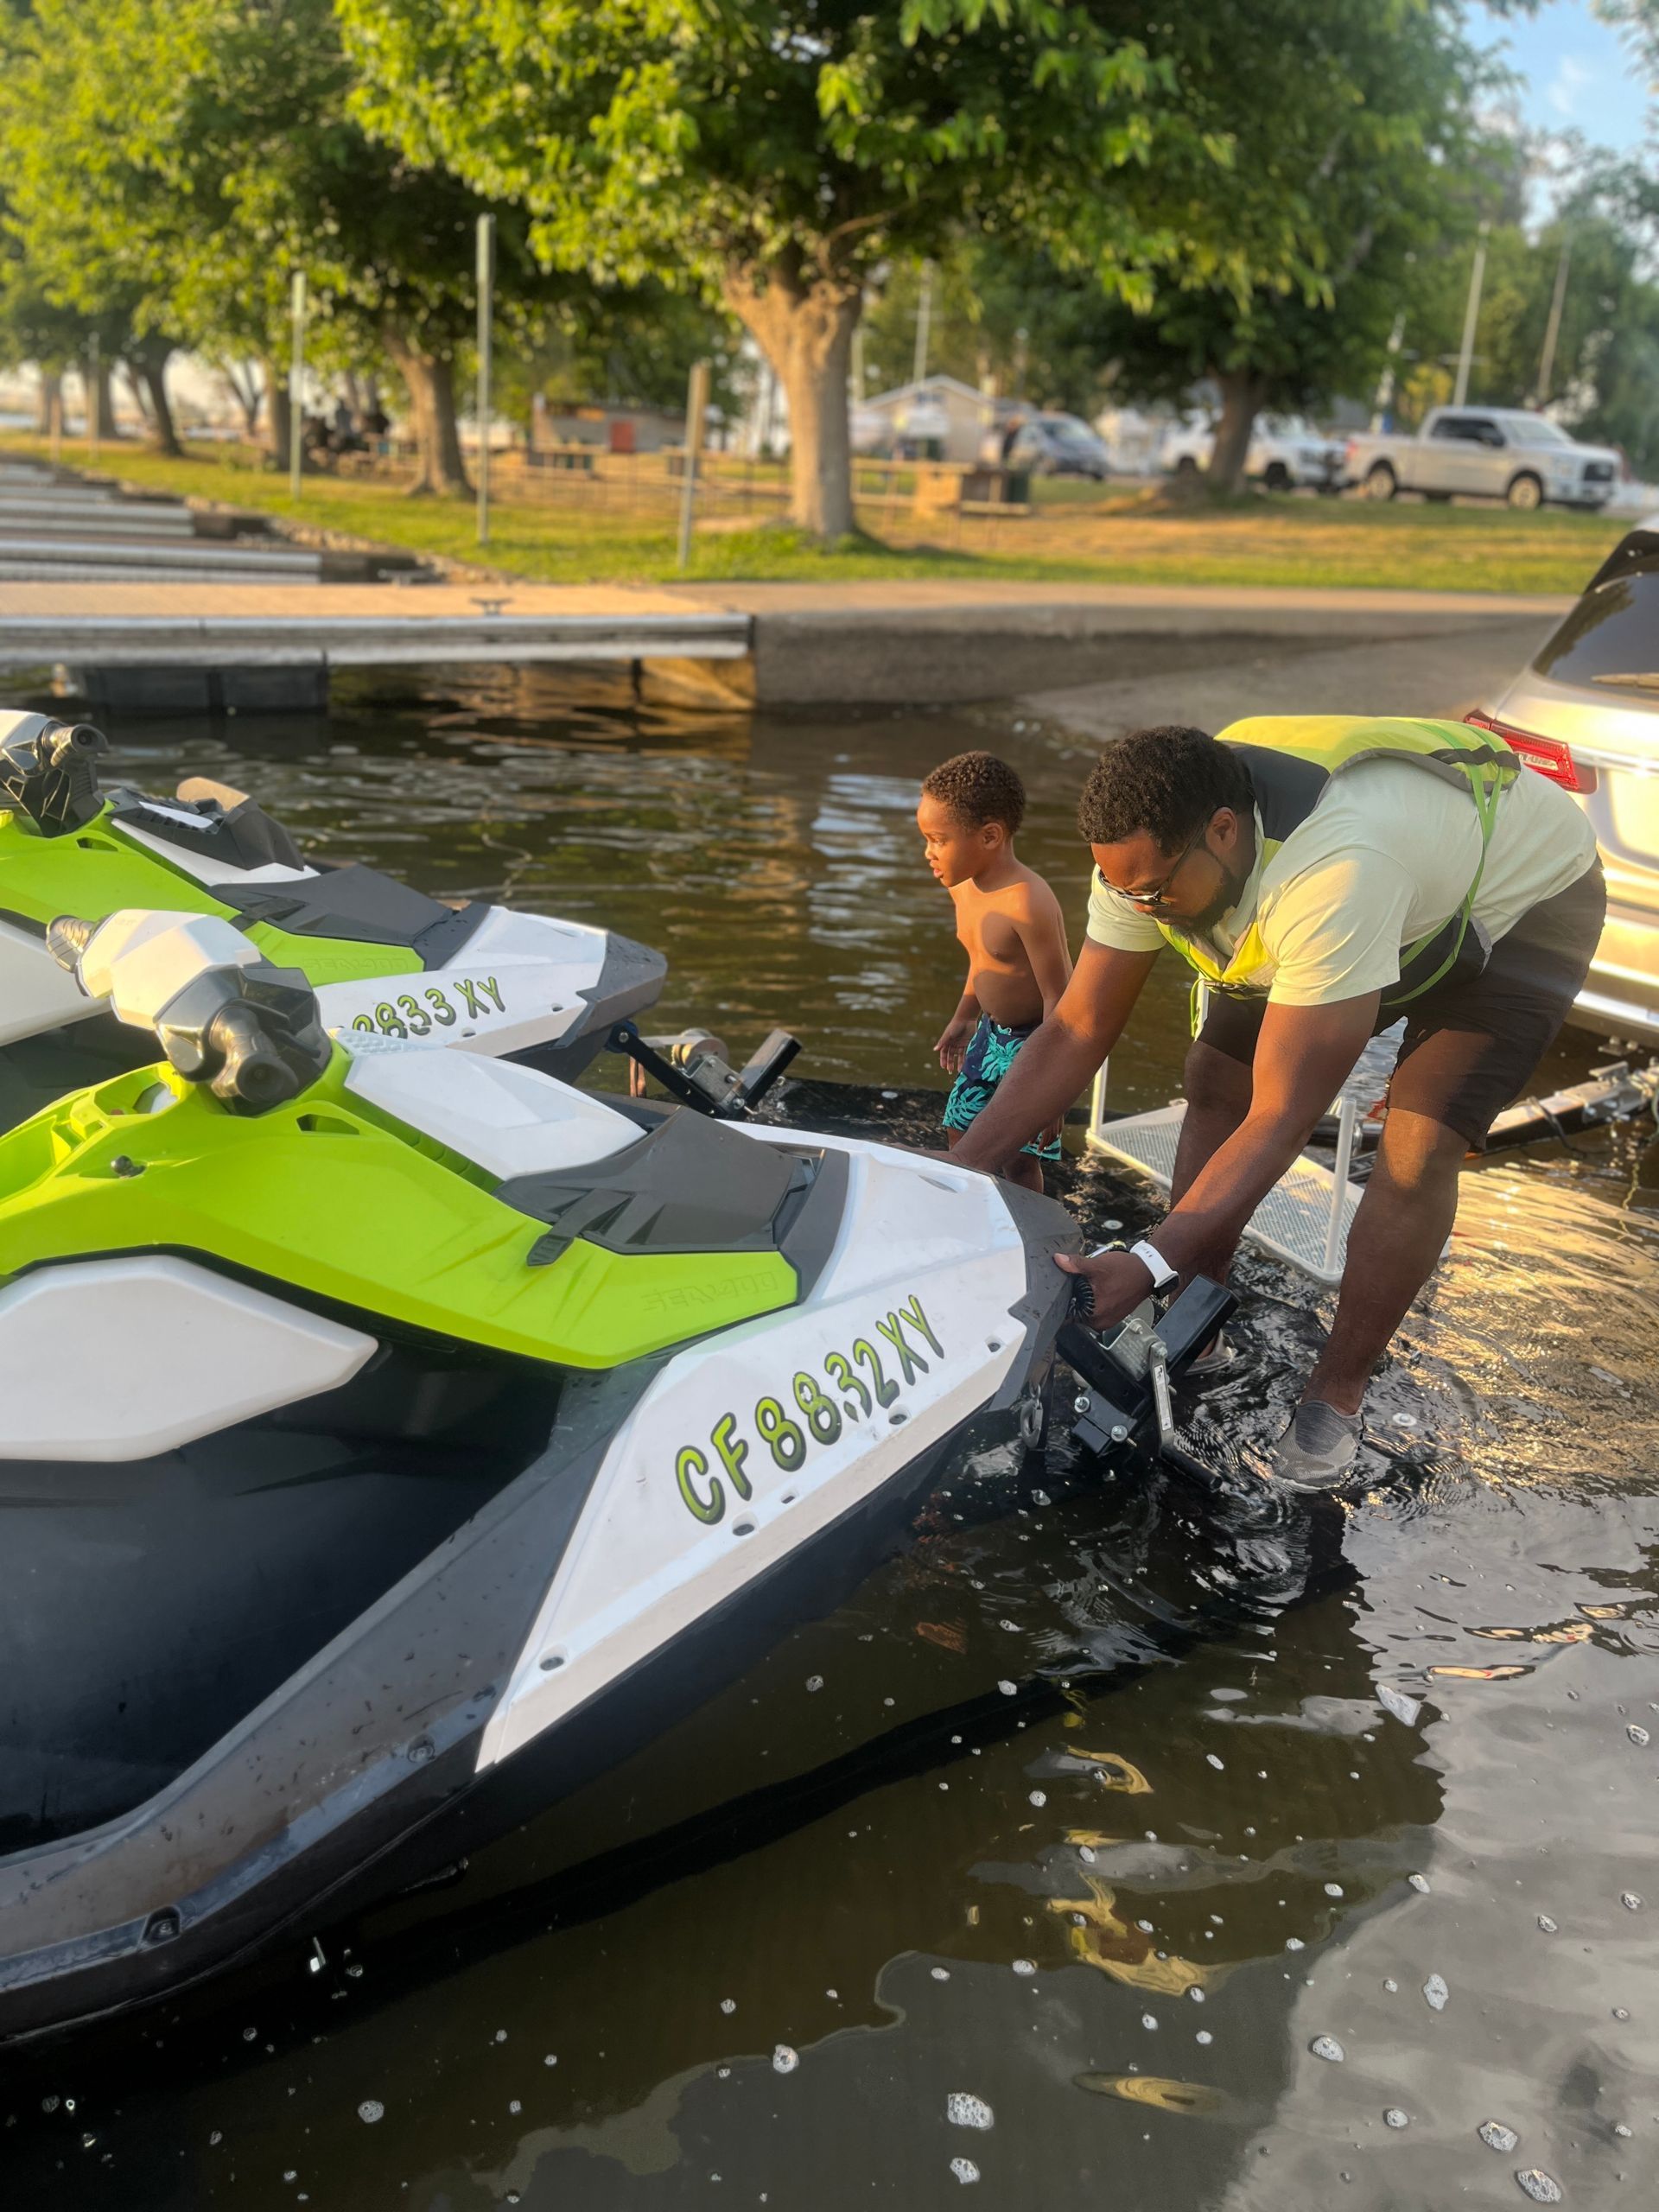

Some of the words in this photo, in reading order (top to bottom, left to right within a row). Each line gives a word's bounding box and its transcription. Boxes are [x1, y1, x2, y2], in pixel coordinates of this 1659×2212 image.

[454, 976, 505, 1019] XY
[675, 1412, 753, 1525] CF
[754, 1338, 899, 1472] 8832
[875, 1294, 944, 1386] XY
